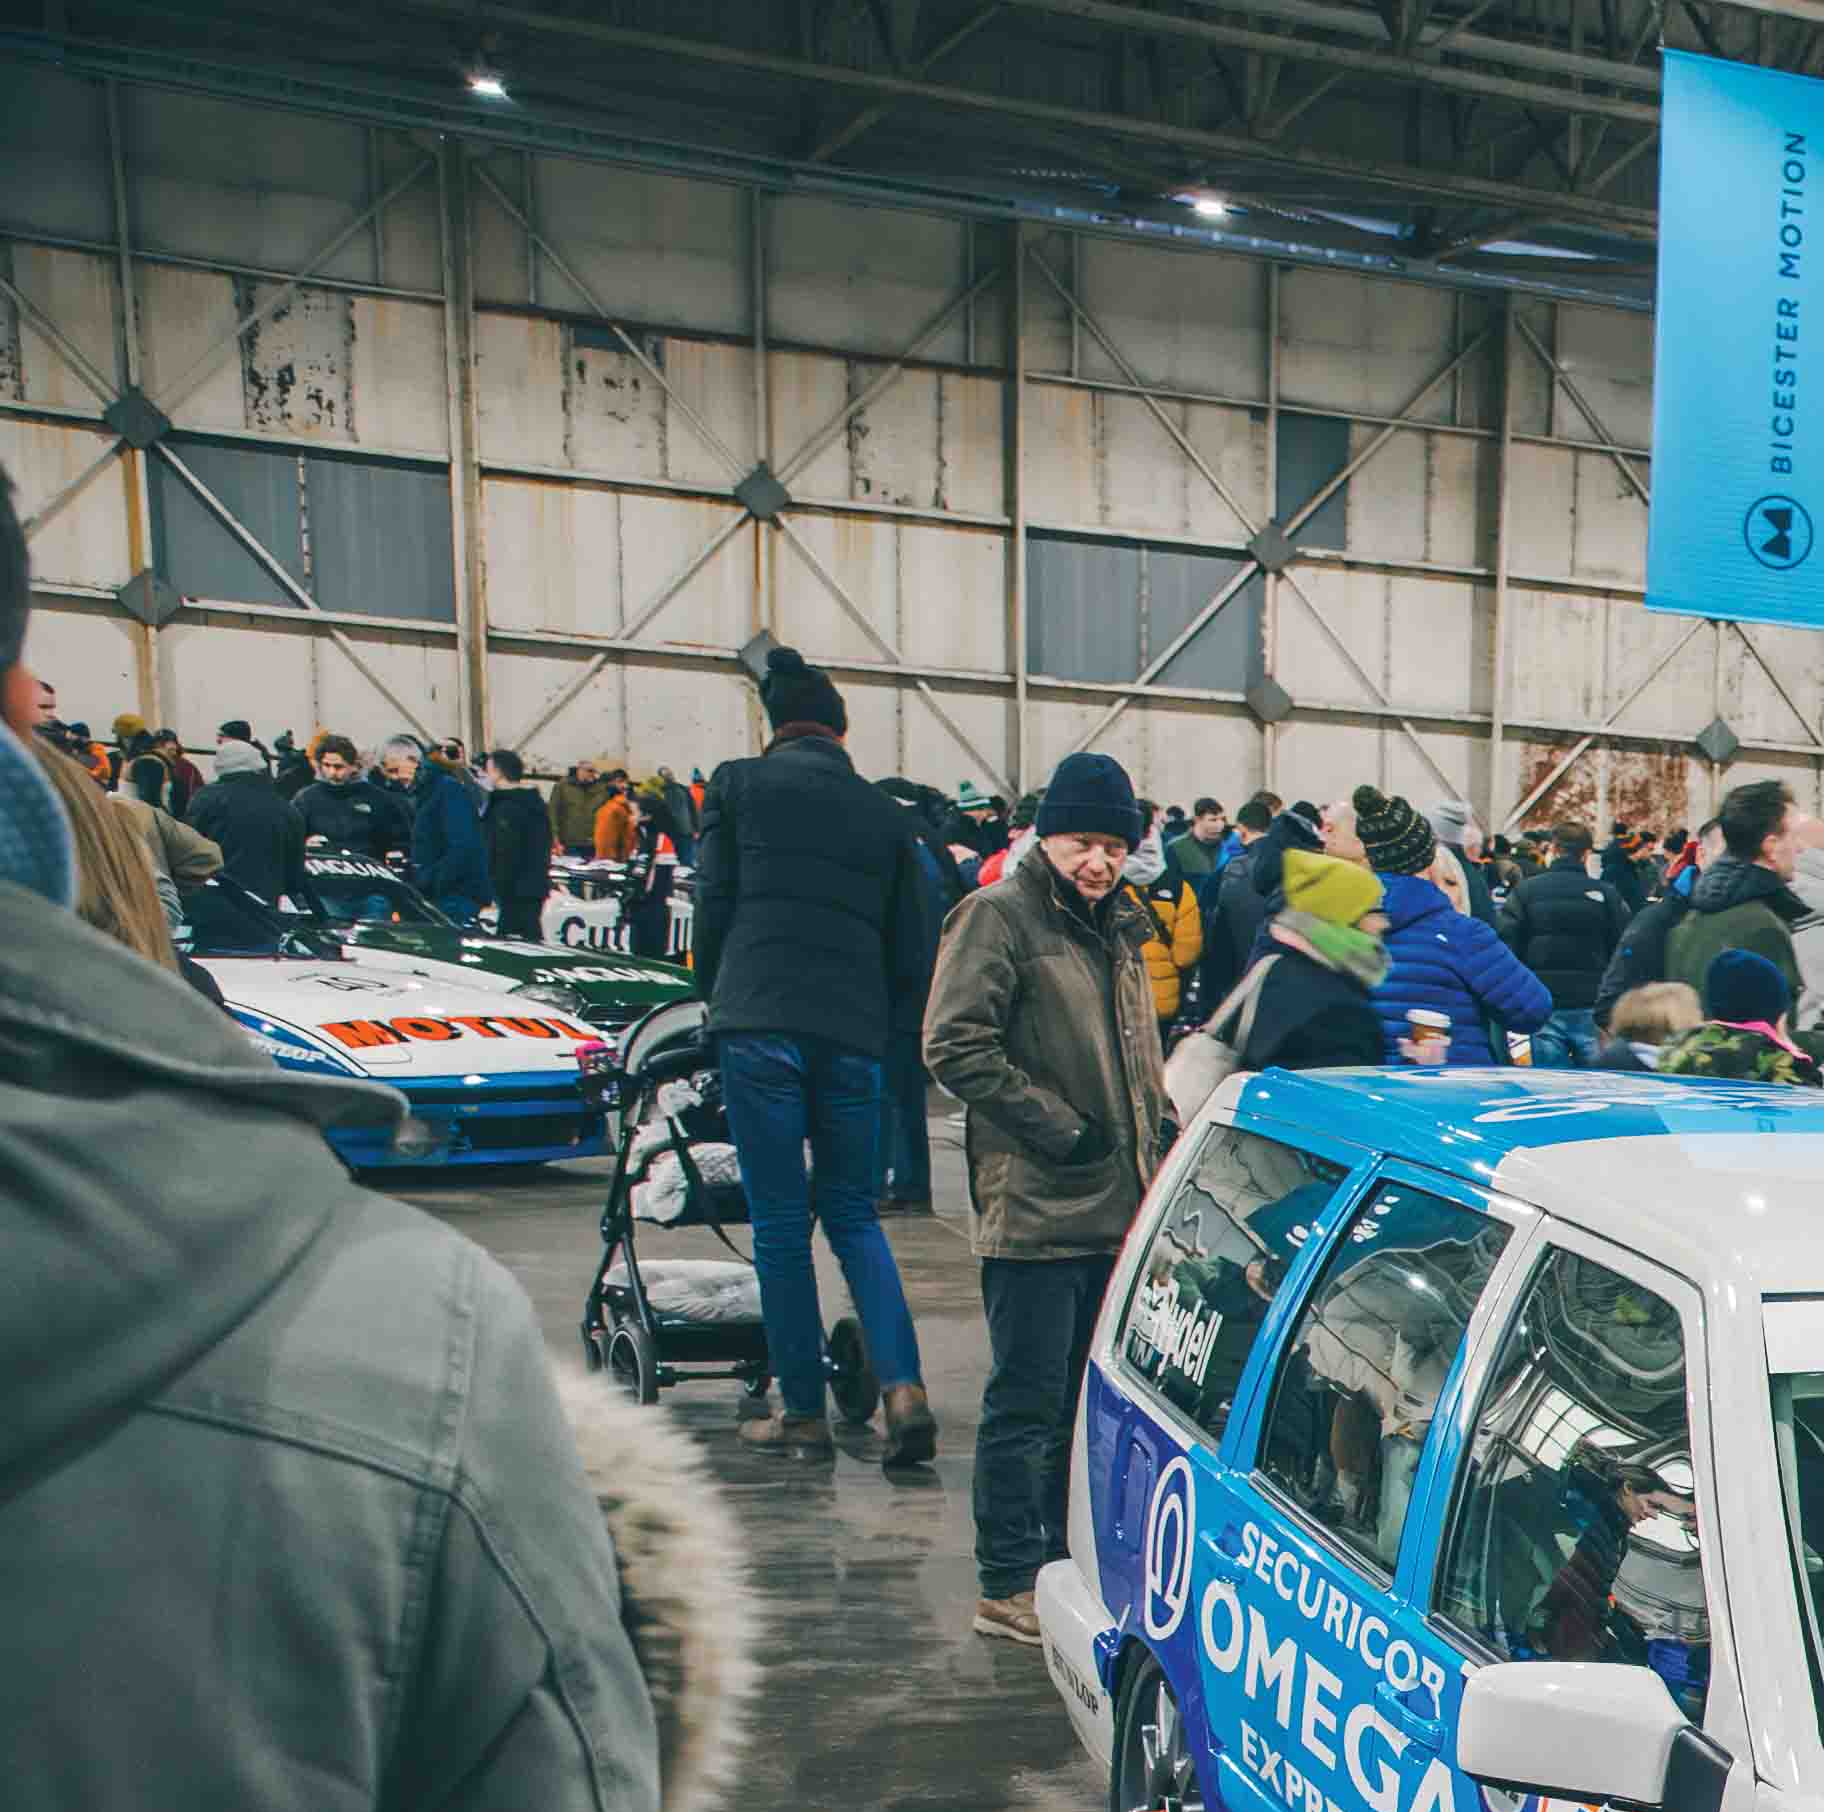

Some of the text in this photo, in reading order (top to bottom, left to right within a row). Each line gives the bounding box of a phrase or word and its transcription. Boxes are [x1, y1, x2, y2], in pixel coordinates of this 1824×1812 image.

[1771, 132, 1807, 475] BICESTER MOTION
[318, 1016, 603, 1050] MOTUL
[1236, 1521, 1446, 1720] SECURICOR
